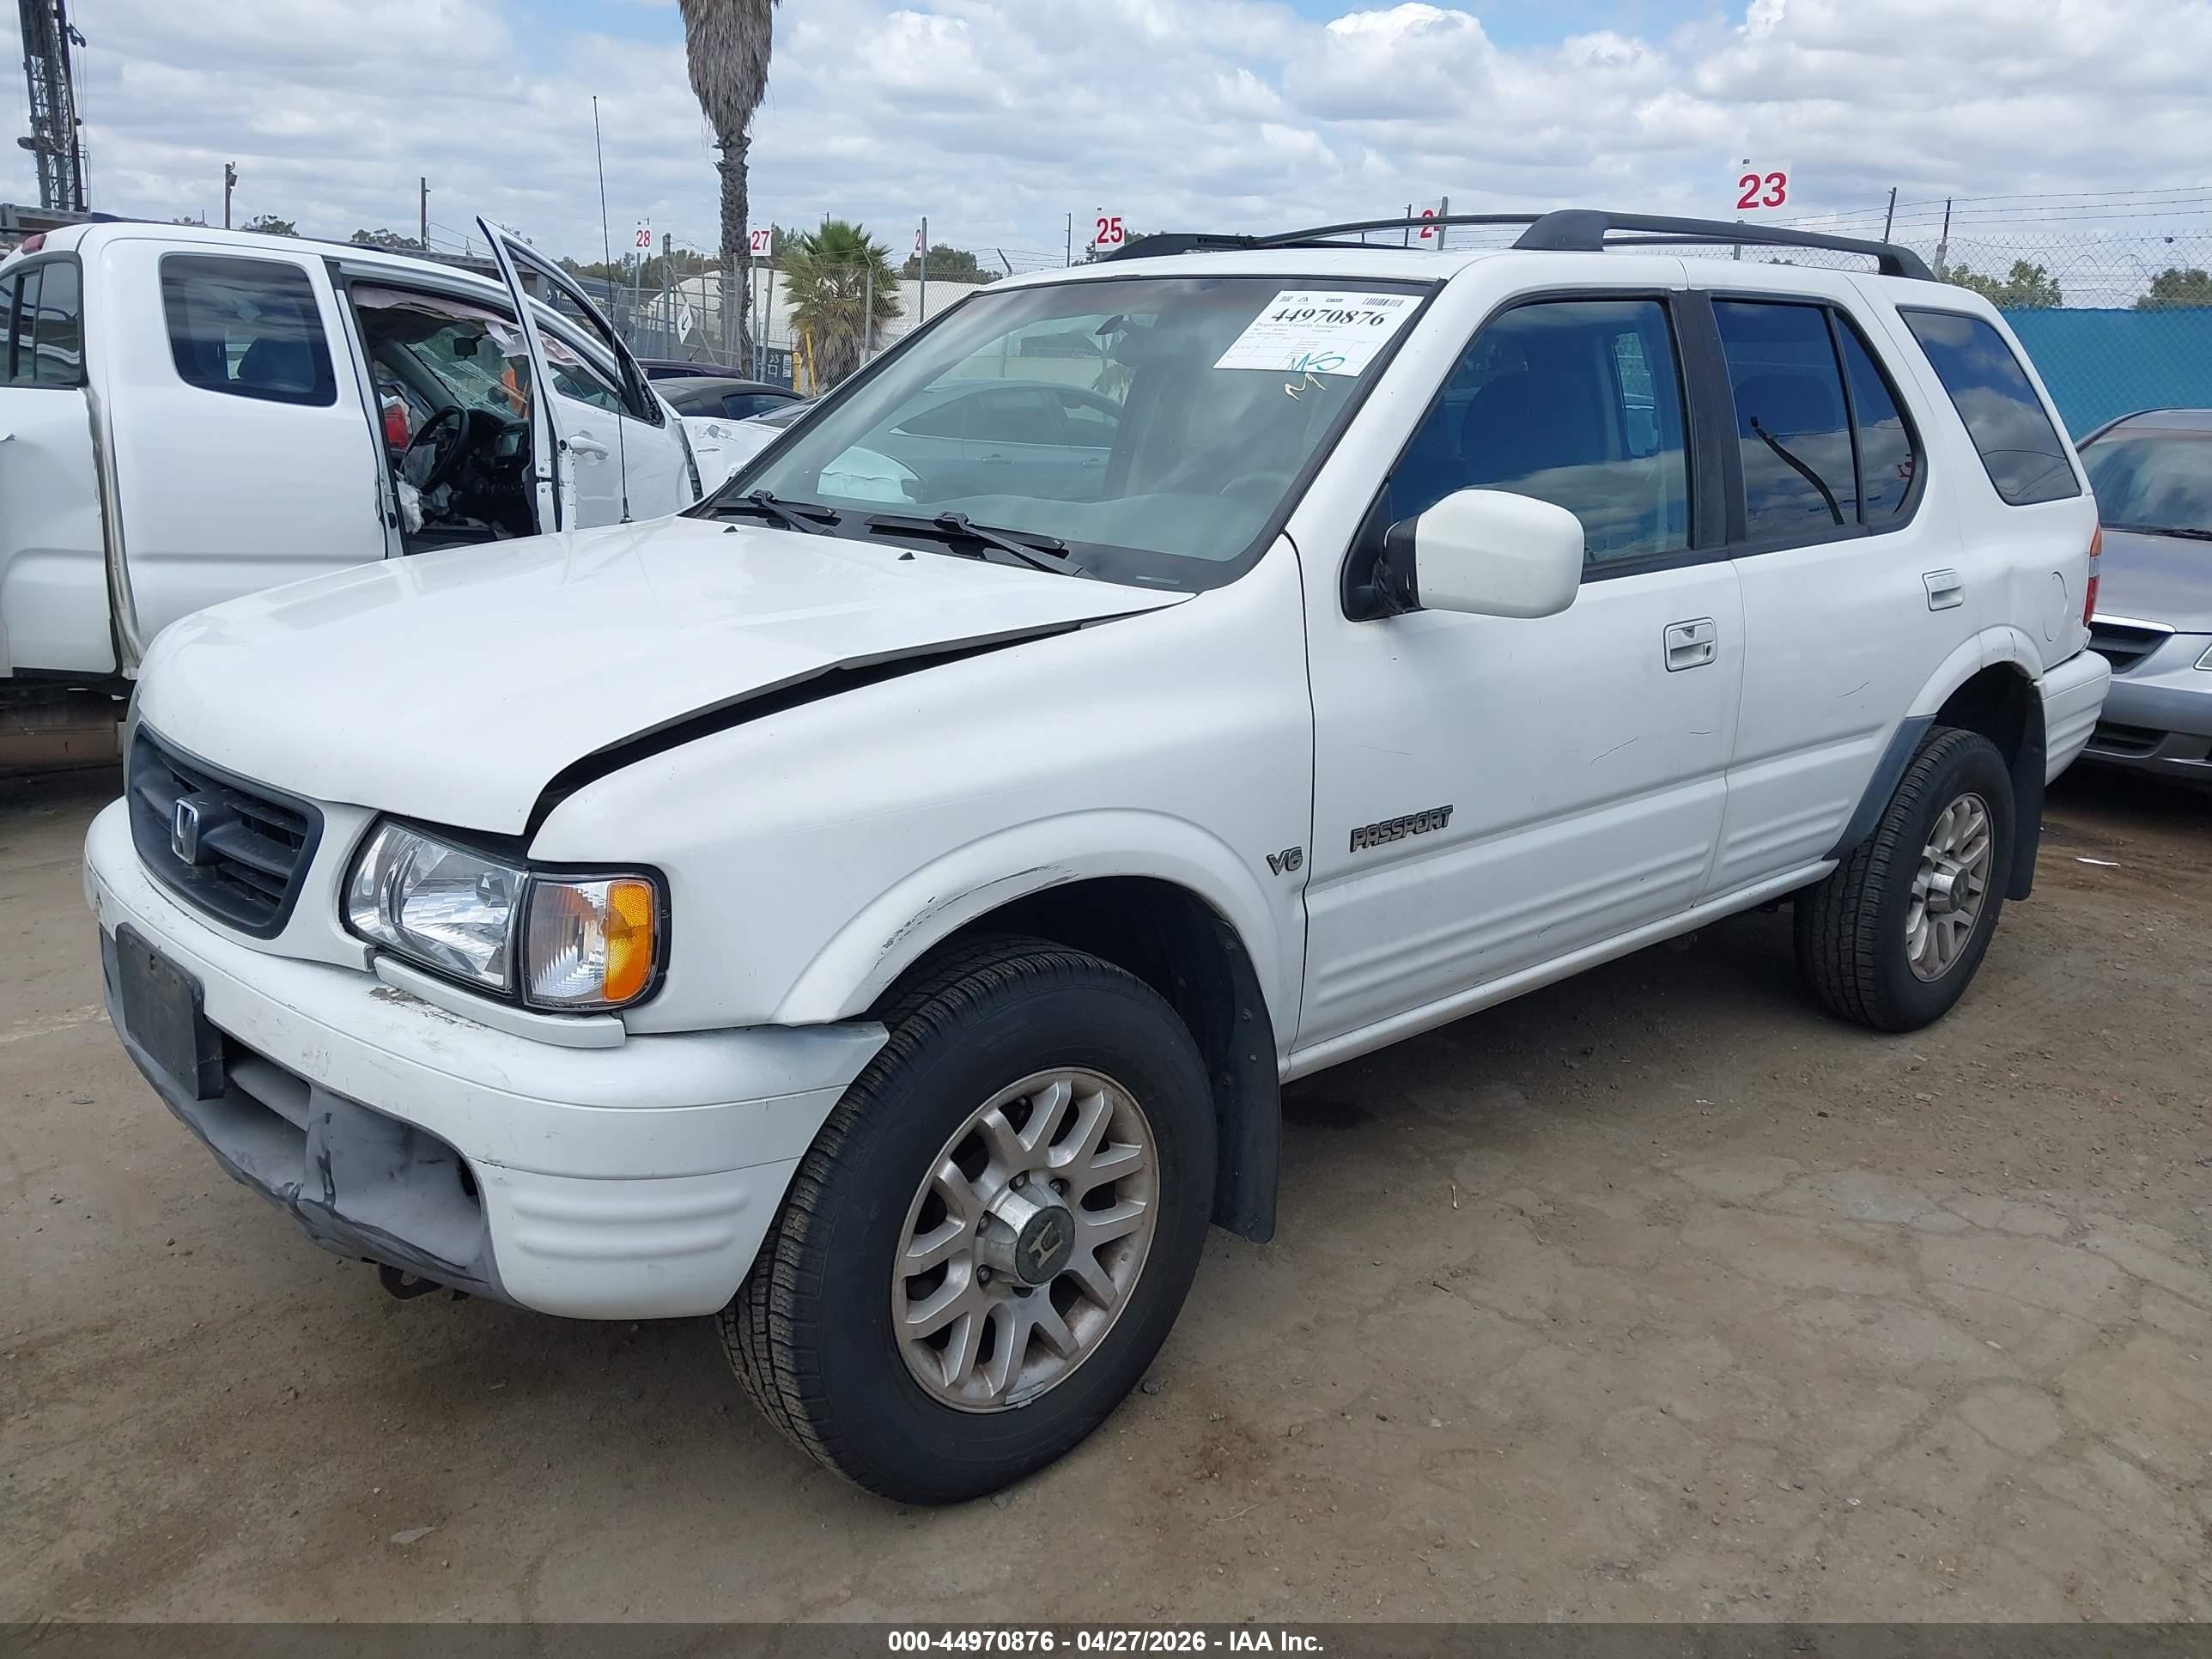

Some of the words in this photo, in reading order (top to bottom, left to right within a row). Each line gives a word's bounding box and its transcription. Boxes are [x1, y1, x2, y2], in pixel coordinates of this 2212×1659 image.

[1736, 172, 1787, 210] 23
[635, 229, 651, 248] 28
[751, 230, 770, 251] 27
[1097, 217, 1123, 244] 25
[1271, 308, 1392, 326] 44970876
[1350, 804, 1454, 853] PASSPORT
[1266, 846, 1304, 876] V6
